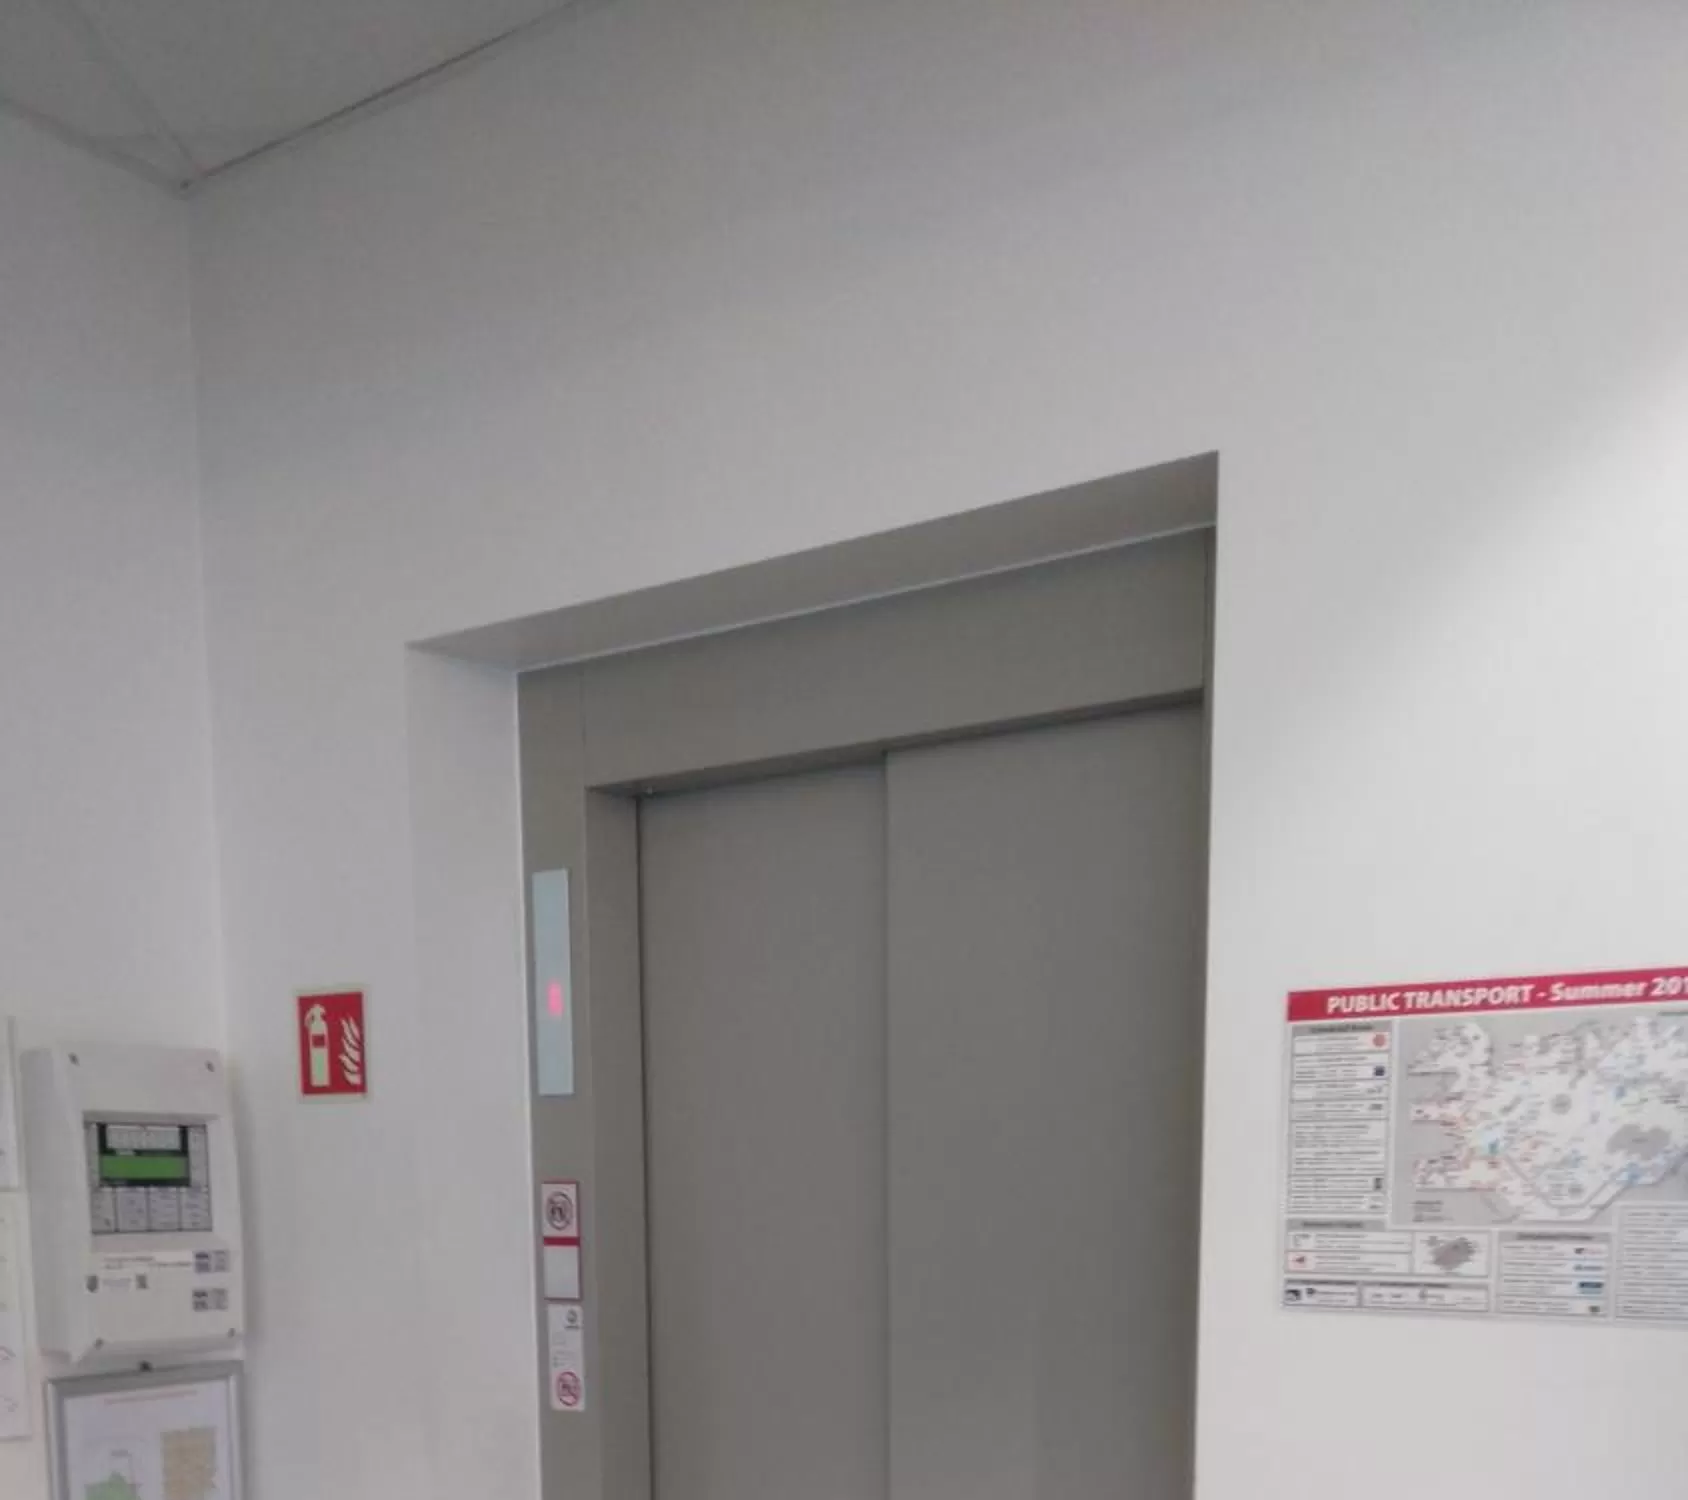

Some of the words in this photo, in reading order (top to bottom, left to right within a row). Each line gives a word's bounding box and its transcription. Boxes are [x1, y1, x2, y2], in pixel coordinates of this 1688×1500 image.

[1327, 992, 1401, 1014] PUBLIC
[1403, 984, 1535, 1010] TRANSPORT
[1548, 981, 1648, 1002] Summer
